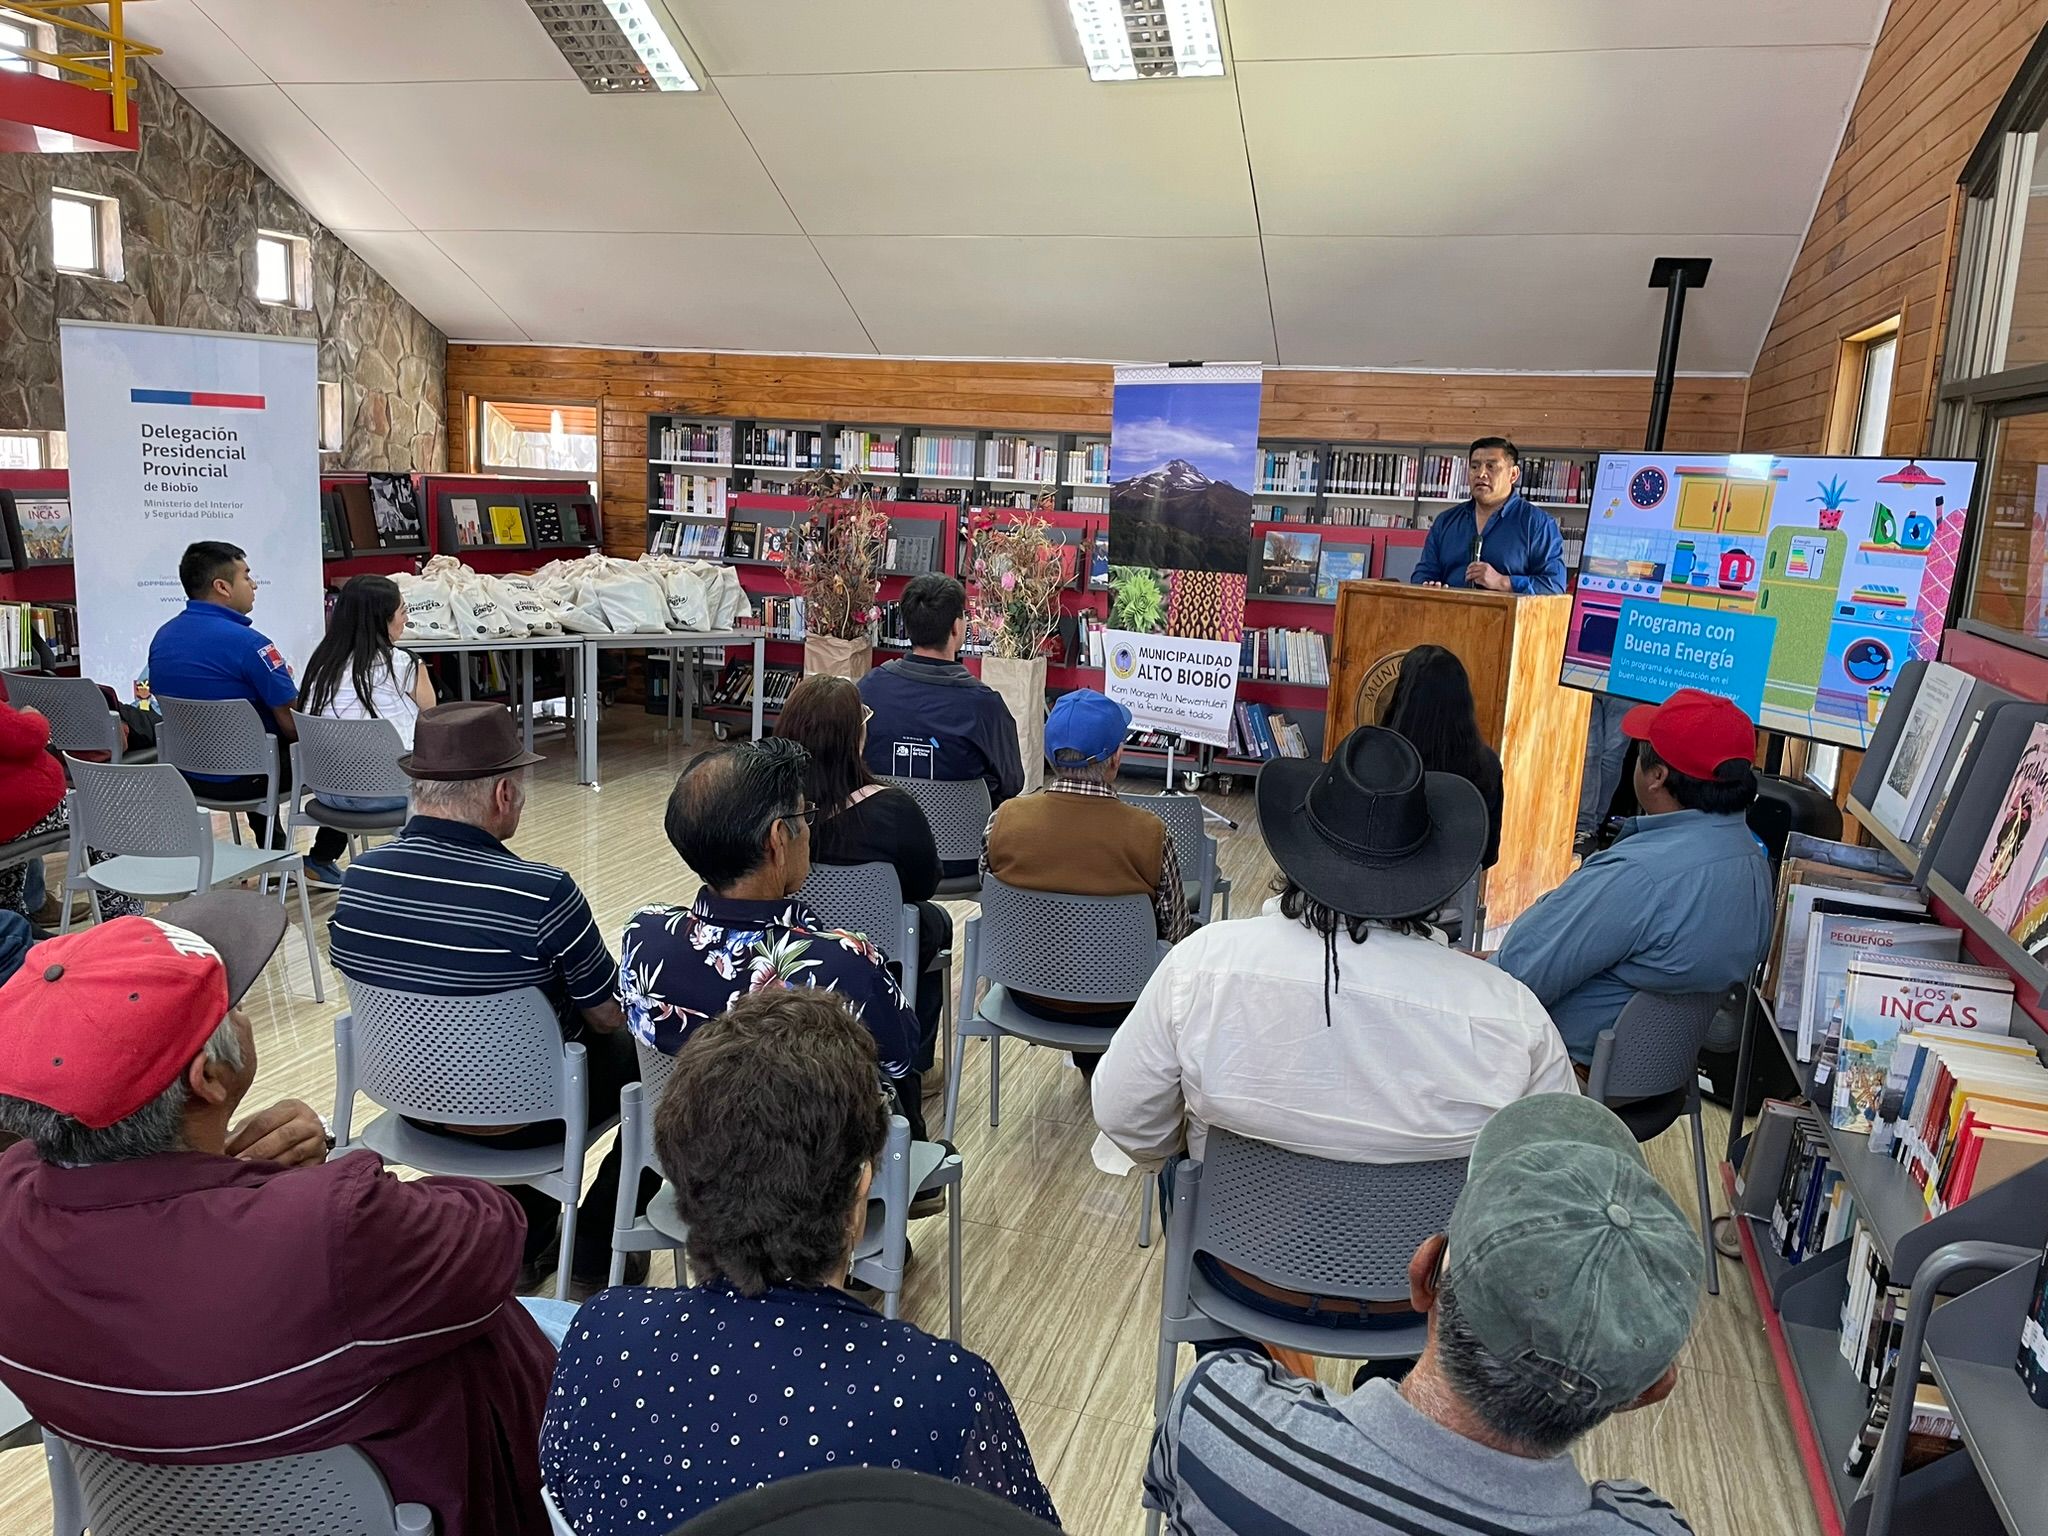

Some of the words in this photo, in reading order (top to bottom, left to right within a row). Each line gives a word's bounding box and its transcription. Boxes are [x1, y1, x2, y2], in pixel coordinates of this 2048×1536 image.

[141, 423, 238, 443] Delegación
[142, 443, 247, 460] Presidencial
[143, 461, 229, 478] Provincial
[144, 482, 158, 492] de
[161, 482, 199, 493] Biobío
[144, 499, 192, 508] Ministerio
[28, 510, 61, 519] INCAS
[144, 510, 150, 518] y
[152, 509, 199, 519] Seguridad
[201, 510, 234, 519] Pública
[1628, 609, 1701, 636] Programa
[1705, 624, 1735, 641] con
[1138, 647, 1233, 667] MUNICIPALIDAD
[1624, 633, 1670, 657] Buena
[1675, 642, 1734, 669] Energía
[1137, 664, 1172, 682] ALTO
[1177, 668, 1231, 689] BIOBÍO
[1618, 670, 1635, 681] buen
[1636, 674, 1647, 683] uso
[1648, 675, 1657, 685] de
[1658, 677, 1668, 687] las
[1620, 657, 1630, 666] Un
[1631, 659, 1662, 673] programa
[1664, 664, 1673, 674] de
[1674, 666, 1710, 682] educación
[1711, 675, 1720, 684] en
[1722, 677, 1729, 685] el
[1111, 684, 1128, 694] Kom
[1130, 687, 1158, 702] Mongen
[1160, 692, 1173, 702] Mu
[1120, 698, 1136, 708] Con
[1137, 701, 1144, 709] la
[1146, 702, 1173, 714] fuerza
[1175, 708, 1186, 716] de
[1189, 708, 1214, 720] todos
[1915, 986, 1946, 1001] LOS
[1880, 995, 1978, 1028] INCAS
